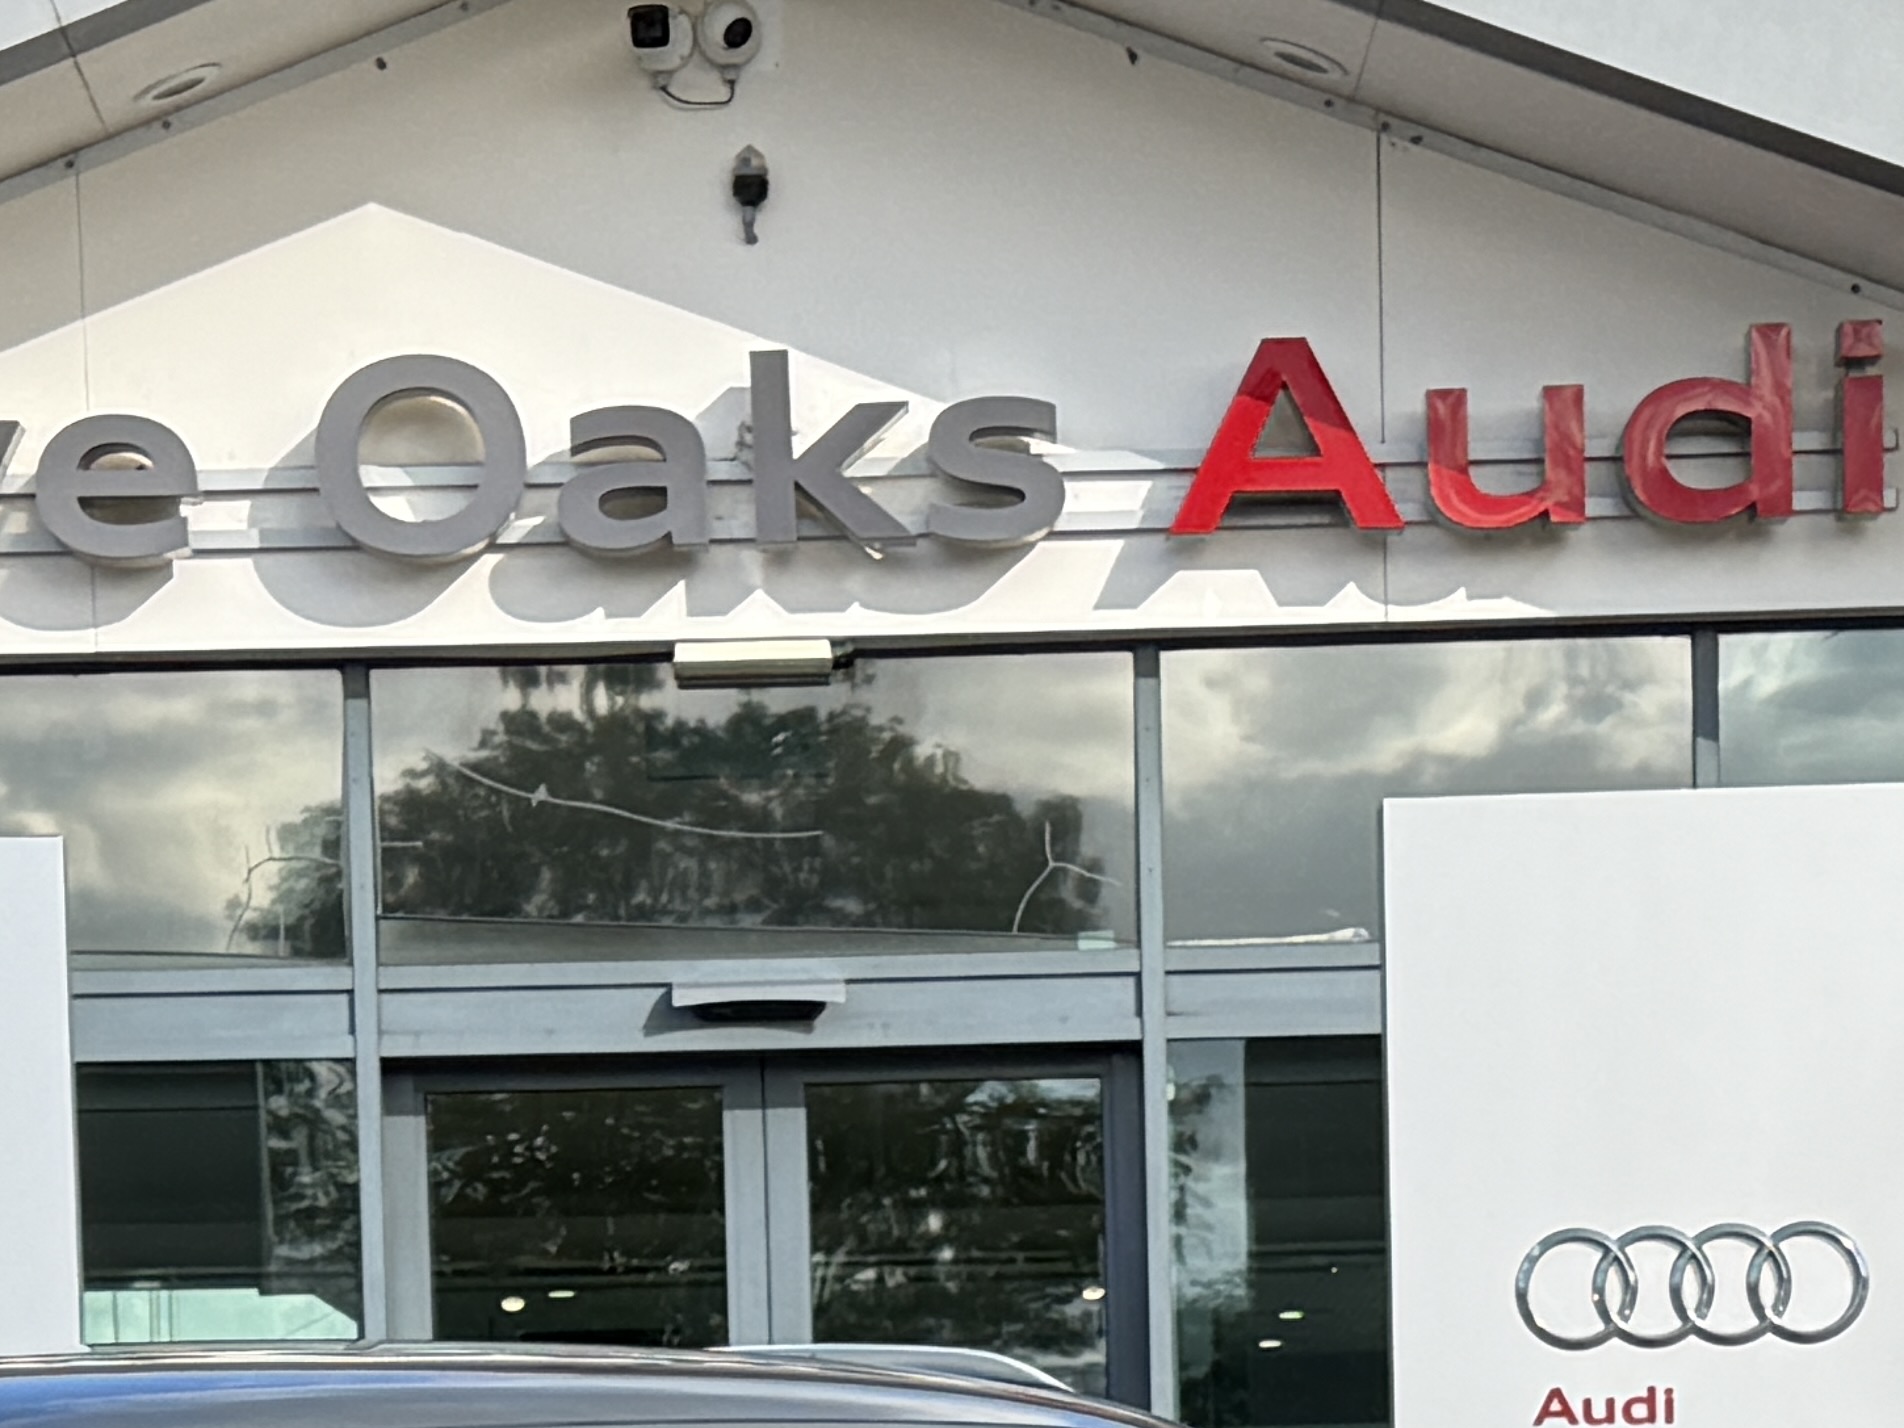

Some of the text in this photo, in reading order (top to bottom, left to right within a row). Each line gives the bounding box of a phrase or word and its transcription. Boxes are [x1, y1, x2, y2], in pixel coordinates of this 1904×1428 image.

[314, 348, 1067, 557] Oaks
[1168, 319, 1885, 535] Audi
[1532, 1385, 1675, 1427] Audi
